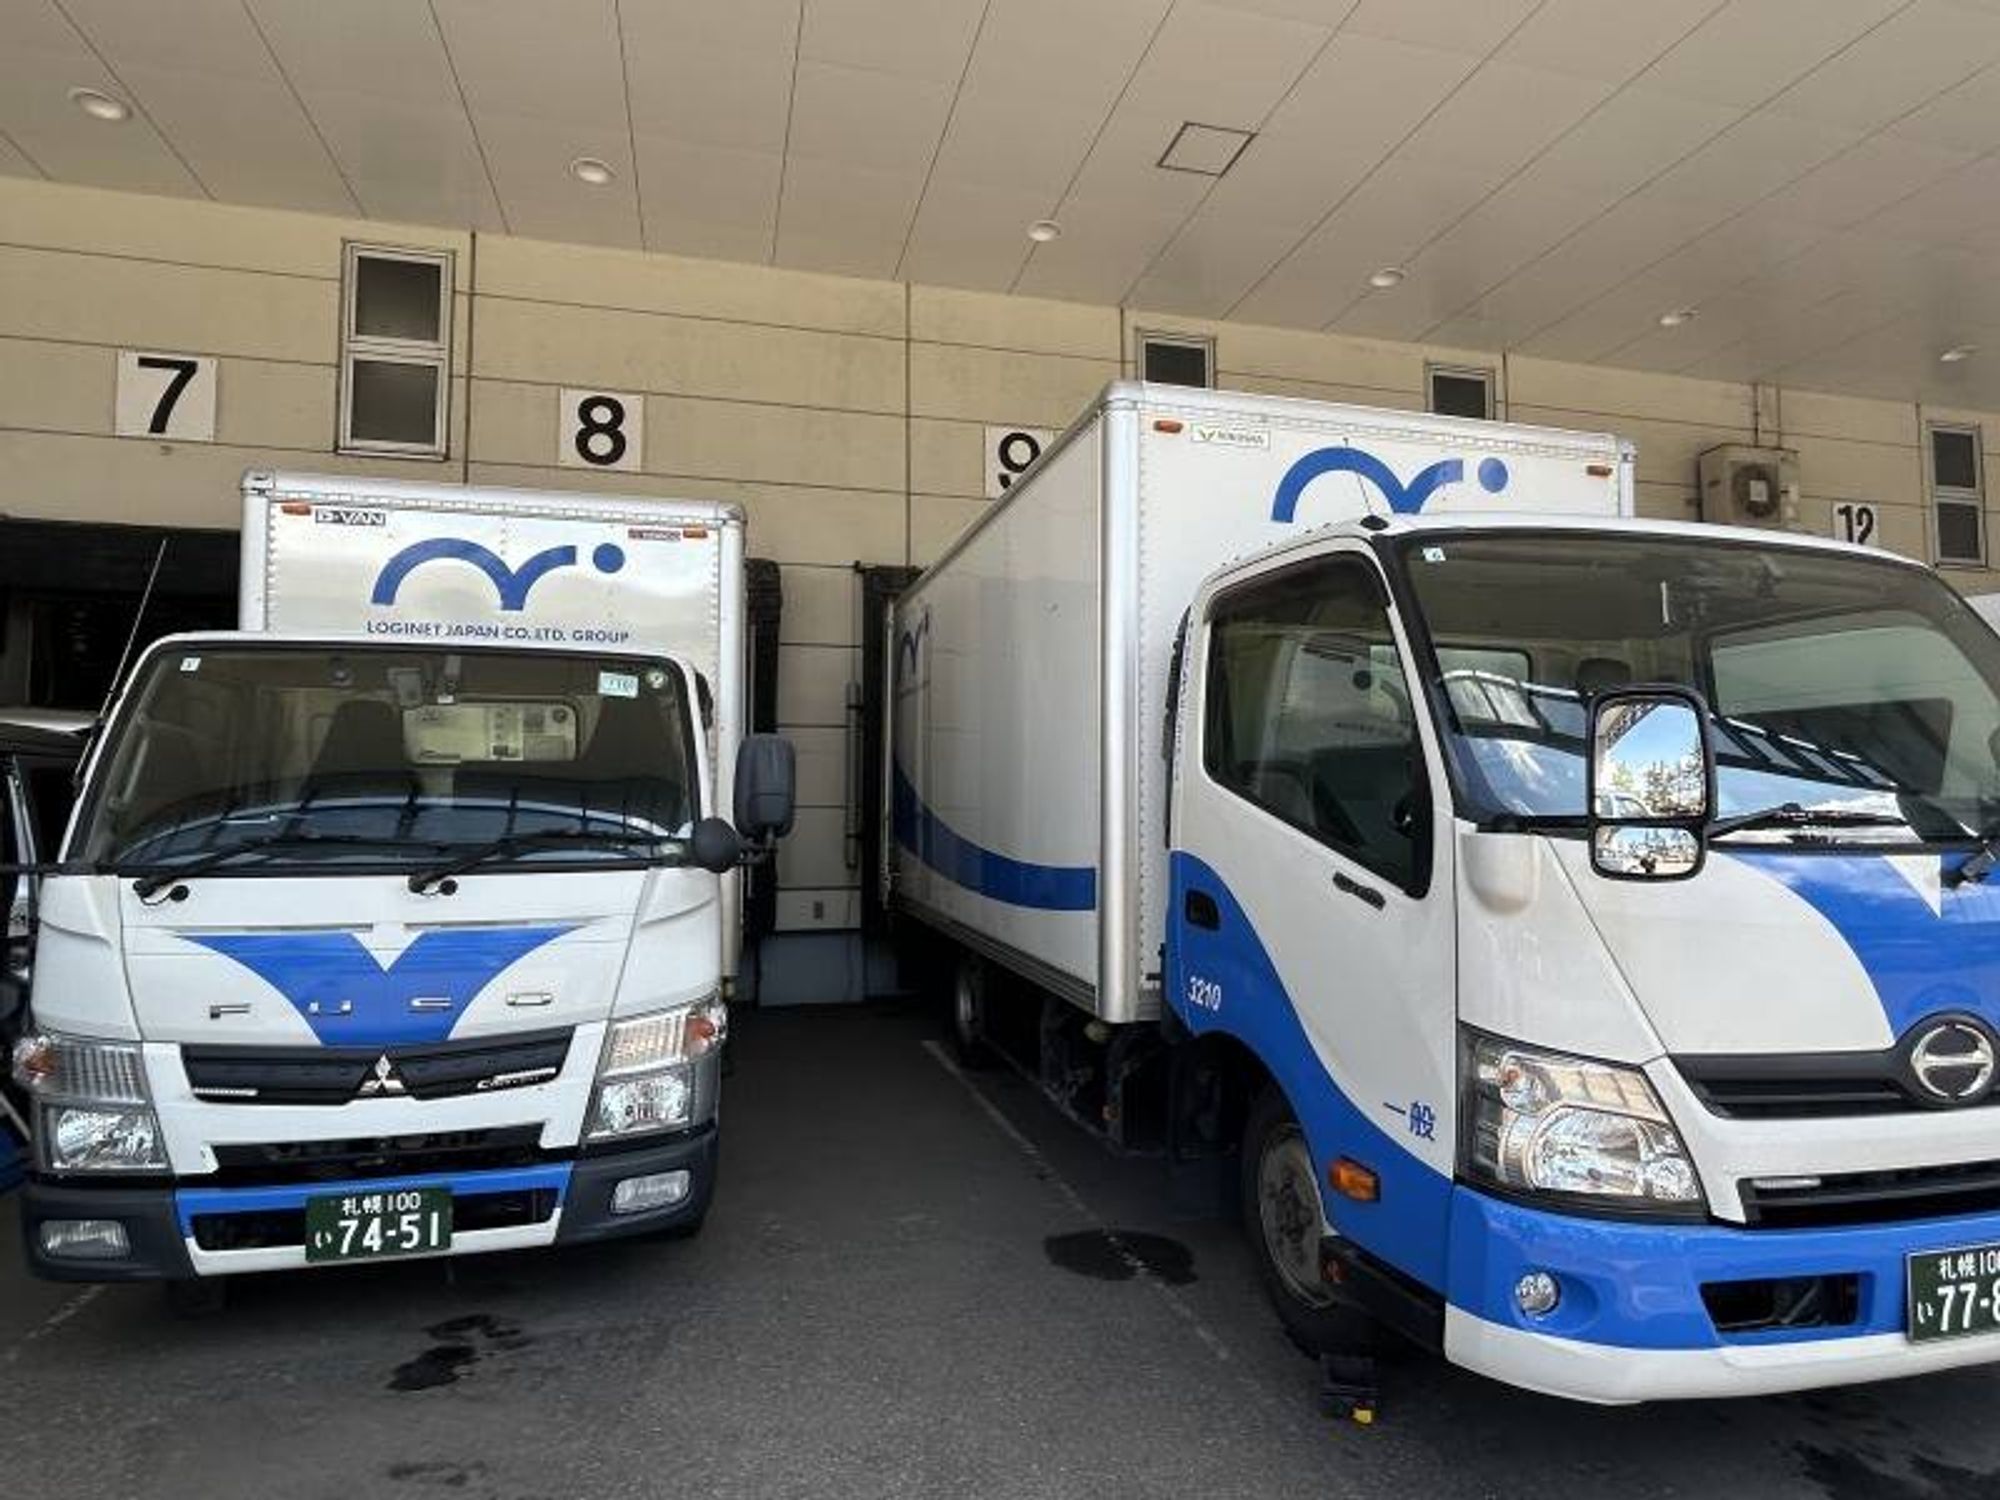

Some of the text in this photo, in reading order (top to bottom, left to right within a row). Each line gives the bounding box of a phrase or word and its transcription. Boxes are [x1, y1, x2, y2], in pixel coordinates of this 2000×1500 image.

[138, 356, 198, 434] 7
[575, 395, 626, 466] 8
[1837, 504, 1874, 545] 12
[366, 620, 440, 636] LOGINET
[444, 624, 499, 638] JAPAN
[572, 629, 629, 643] GROUP
[1187, 976, 1221, 1011] 3210
[1382, 1101, 1436, 1141] 一般
[338, 1211, 439, 1254] 74-51
